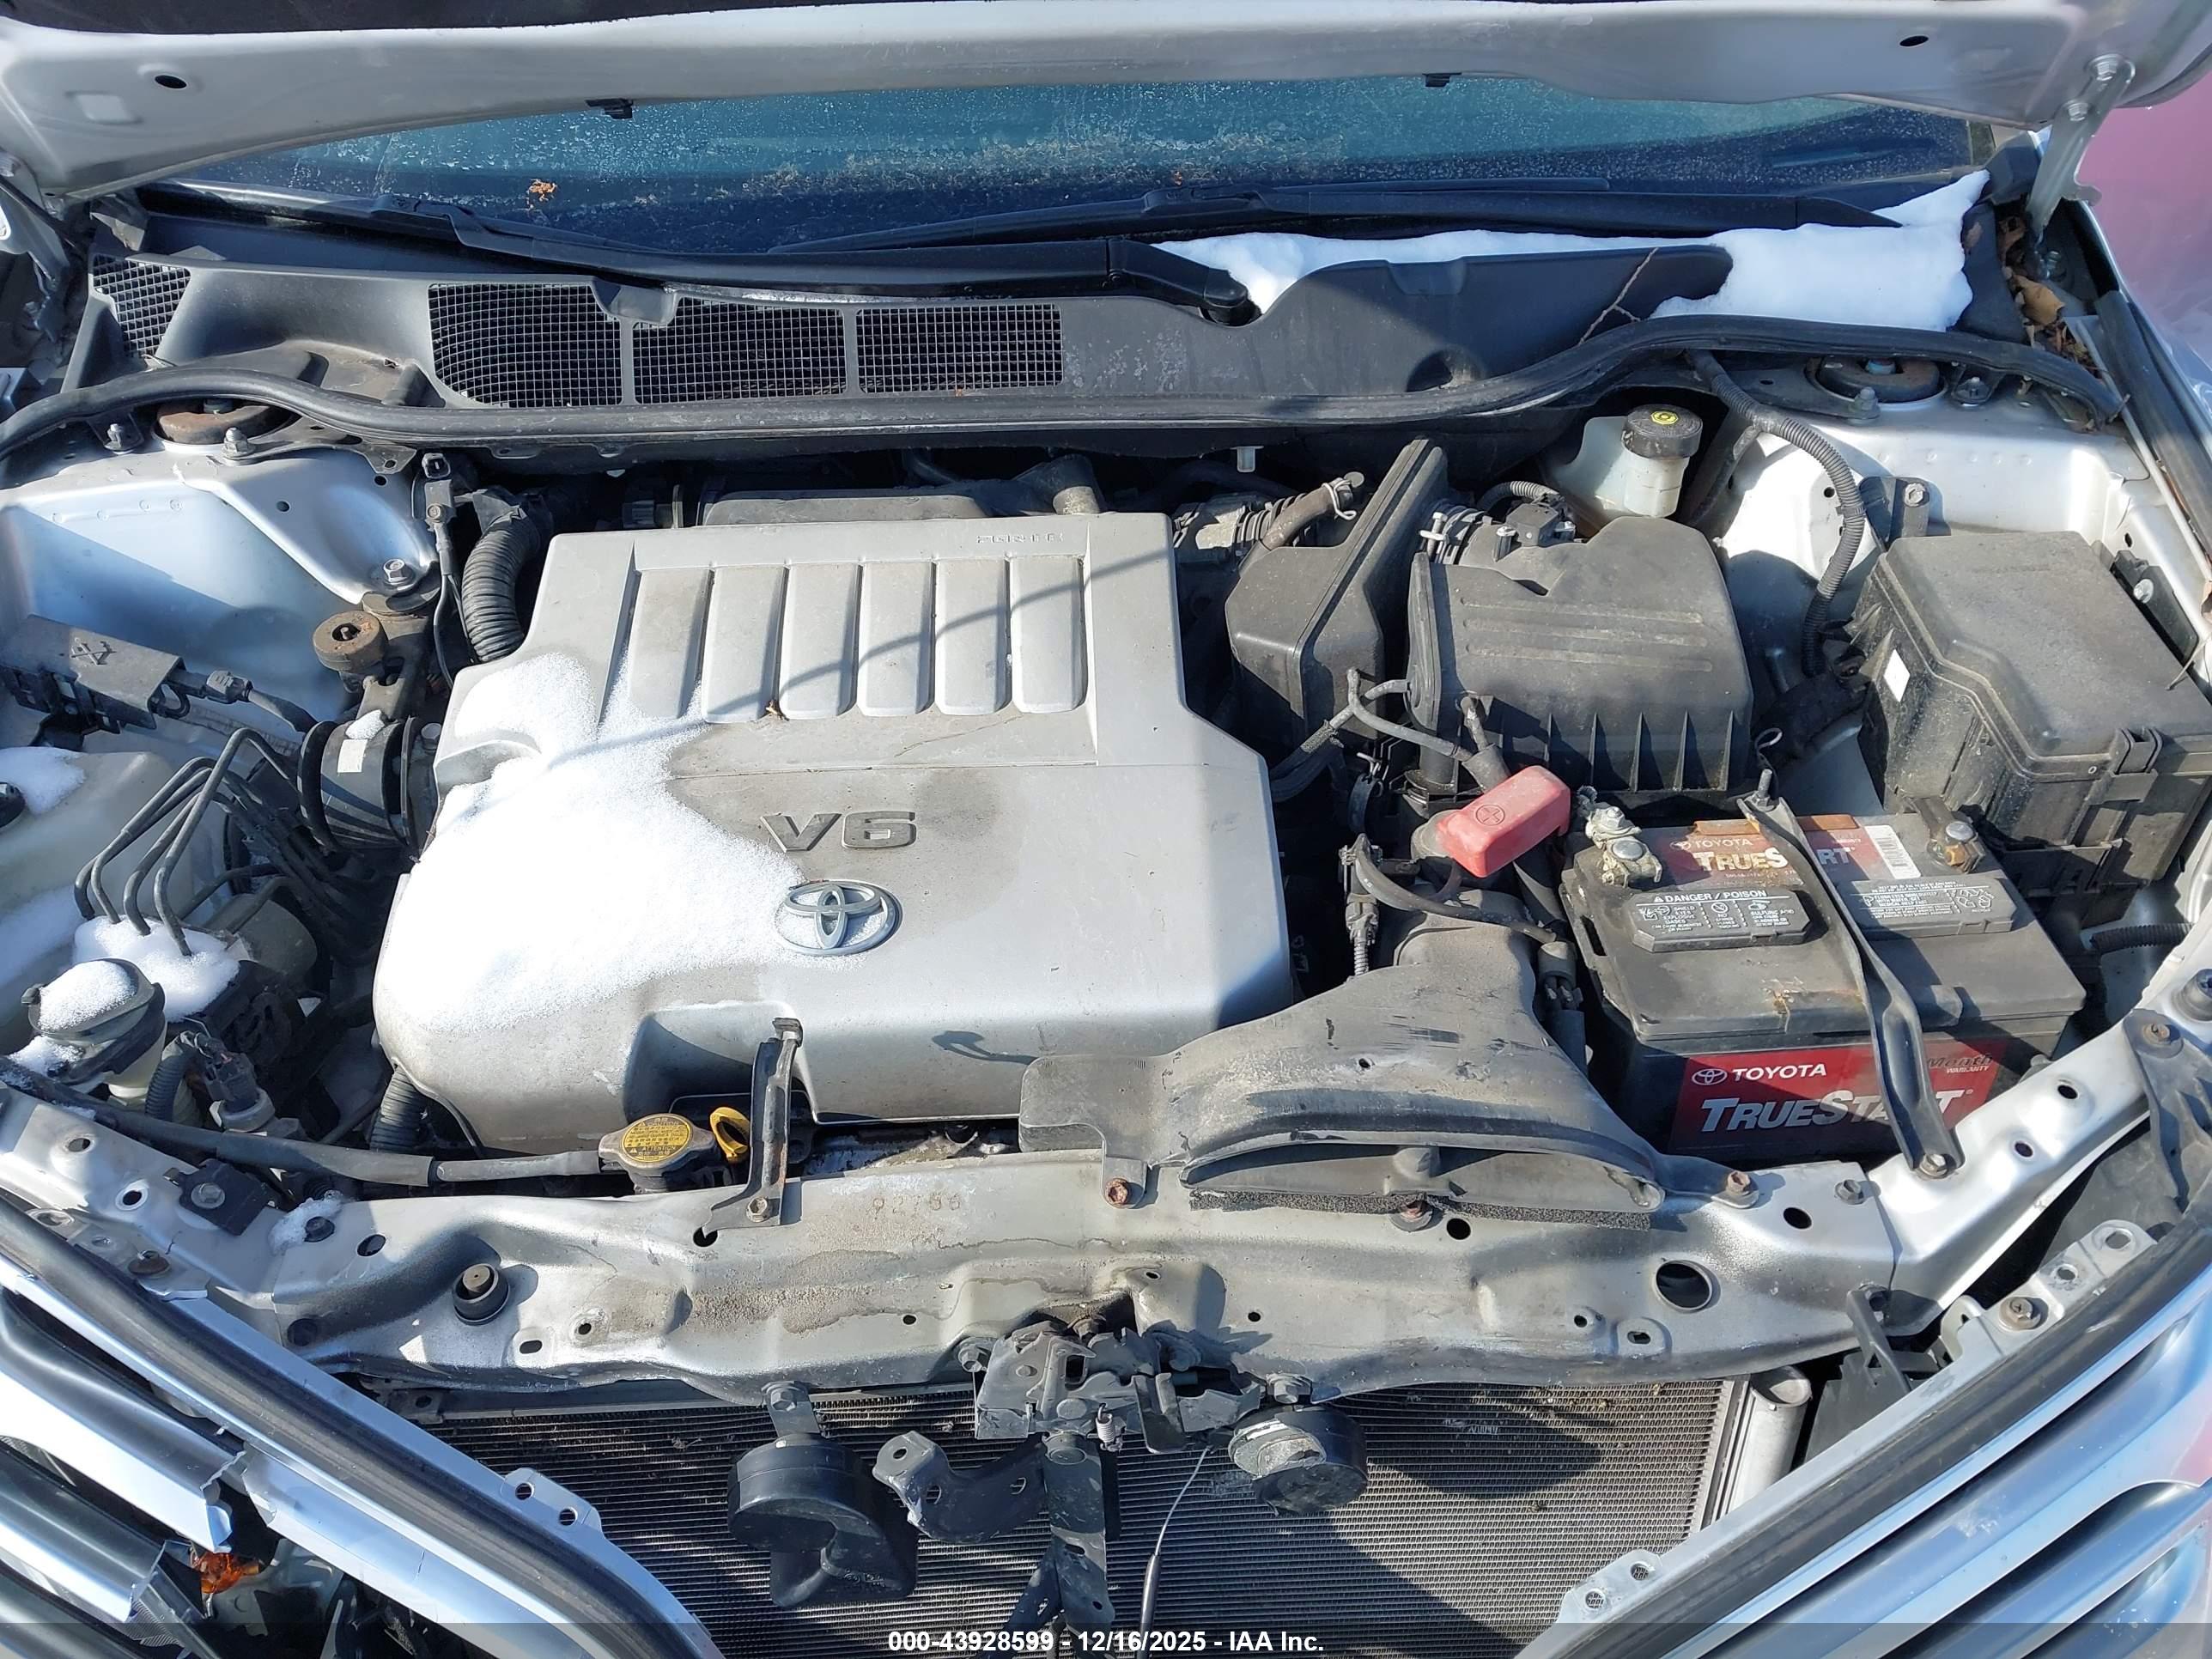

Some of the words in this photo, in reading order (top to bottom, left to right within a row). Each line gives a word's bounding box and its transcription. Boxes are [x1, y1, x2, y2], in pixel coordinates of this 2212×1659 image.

[759, 811, 917, 853] V6
[1694, 838, 1753, 848] TOYOTA
[1664, 892, 1712, 902] DANGER
[1723, 890, 1767, 899] POISON
[1732, 1063, 1827, 1082] TOYOTA
